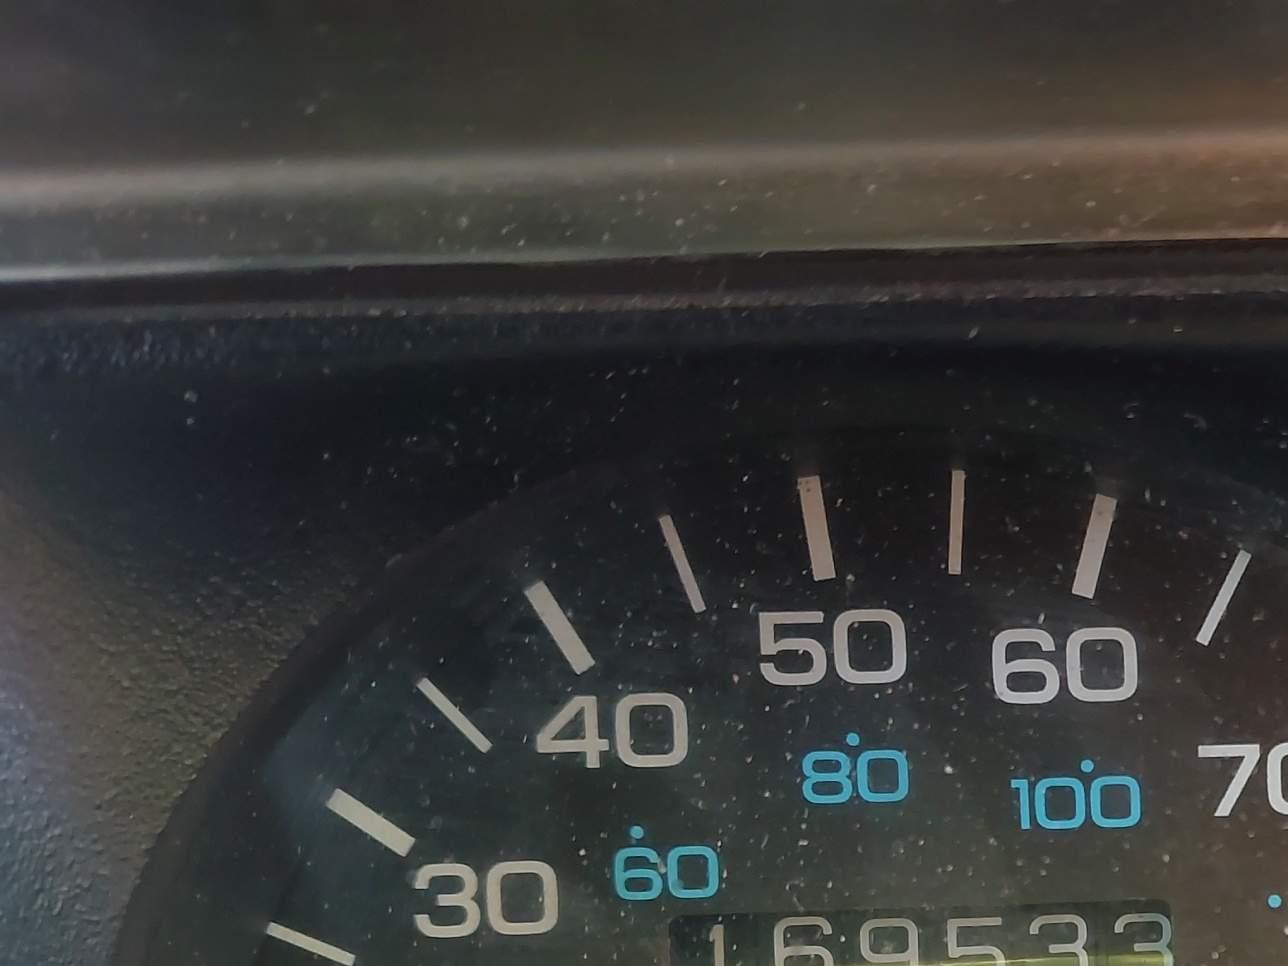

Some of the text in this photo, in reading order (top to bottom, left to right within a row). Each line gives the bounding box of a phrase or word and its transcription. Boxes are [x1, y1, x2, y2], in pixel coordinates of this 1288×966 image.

[758, 608, 908, 686] 50
[991, 626, 1139, 705] 60
[535, 692, 690, 769] 40
[801, 749, 910, 804] 80
[1010, 775, 1142, 831] 100
[413, 860, 560, 939] 30
[613, 845, 721, 901] 60
